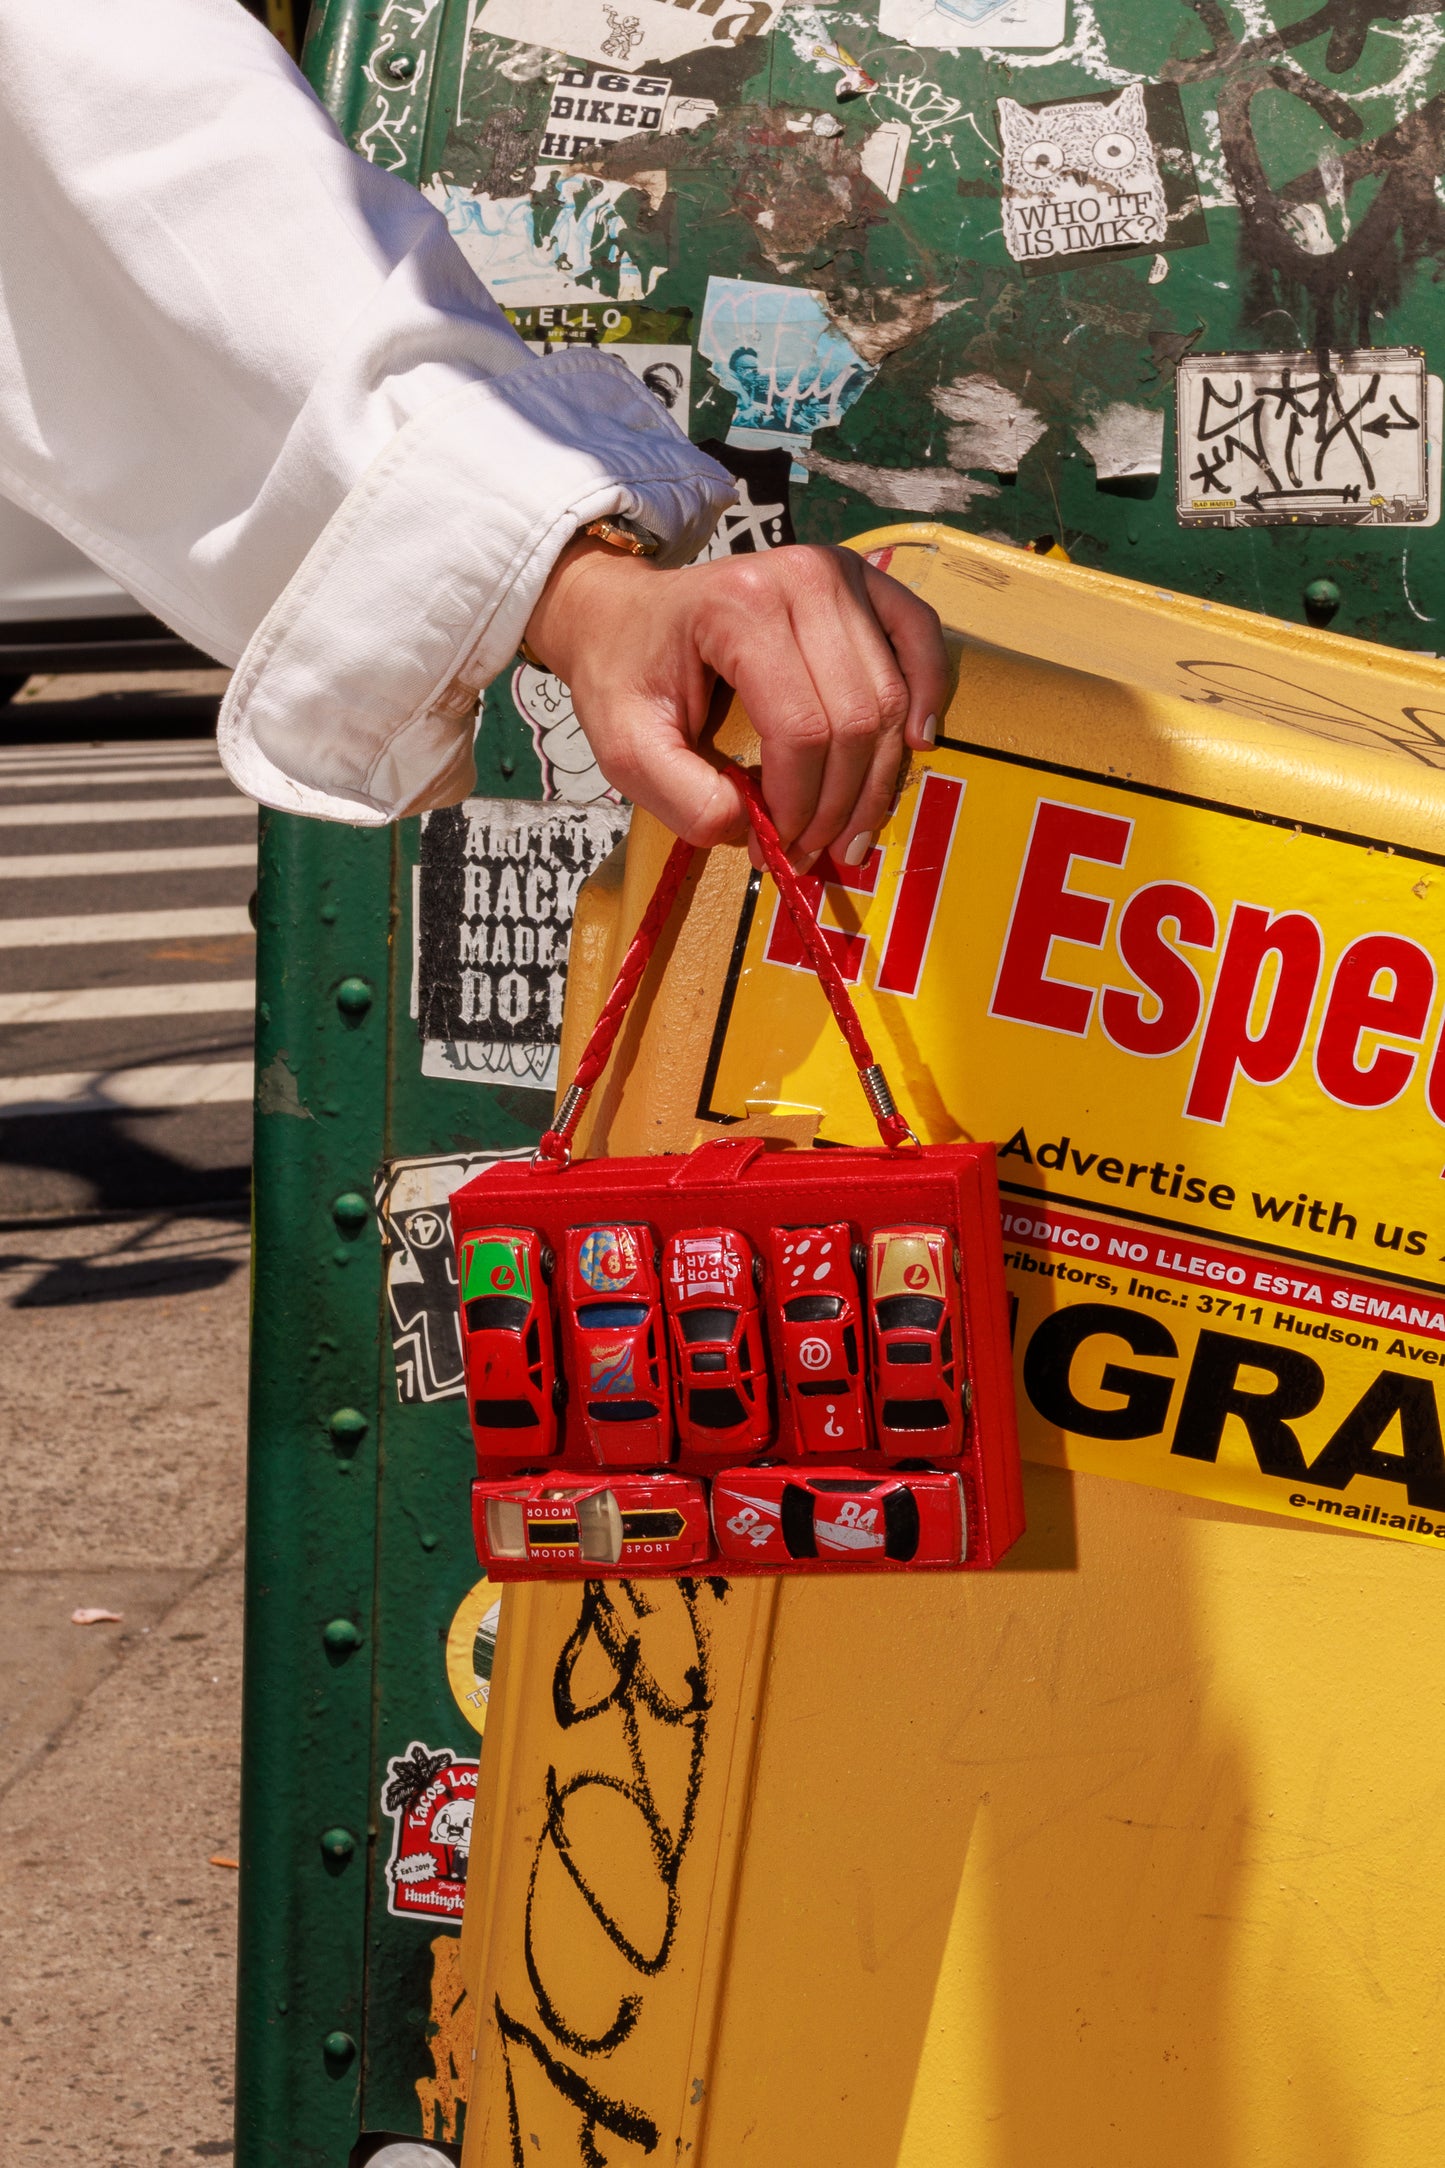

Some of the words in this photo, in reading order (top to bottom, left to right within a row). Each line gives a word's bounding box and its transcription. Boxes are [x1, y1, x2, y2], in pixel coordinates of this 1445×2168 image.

[550, 96, 662, 129] BIKED
[1015, 198, 1100, 230] WHO
[1107, 191, 1153, 218] TF
[1019, 229, 1054, 257] IS
[1061, 215, 1157, 251] IMK?
[996, 1126, 1236, 1210] Advertise
[1252, 1192, 1358, 1240] with
[1374, 1222, 1428, 1256] us
[1000, 1212, 1100, 1251] IODICO
[1107, 1237, 1149, 1262] NO
[1155, 1249, 1247, 1286] LLEGO
[1253, 1271, 1323, 1304] ESTA
[1330, 1289, 1445, 1332] SEMANA
[1128, 1278, 1188, 1308] Inc.:
[1195, 1294, 1264, 1326] 3711
[1272, 1311, 1379, 1352] Hudson
[726, 1507, 776, 1548] 84
[530, 1549, 576, 1559] MOTOR
[626, 1543, 671, 1554] SPORT
[408, 1778, 447, 1831] Tacos
